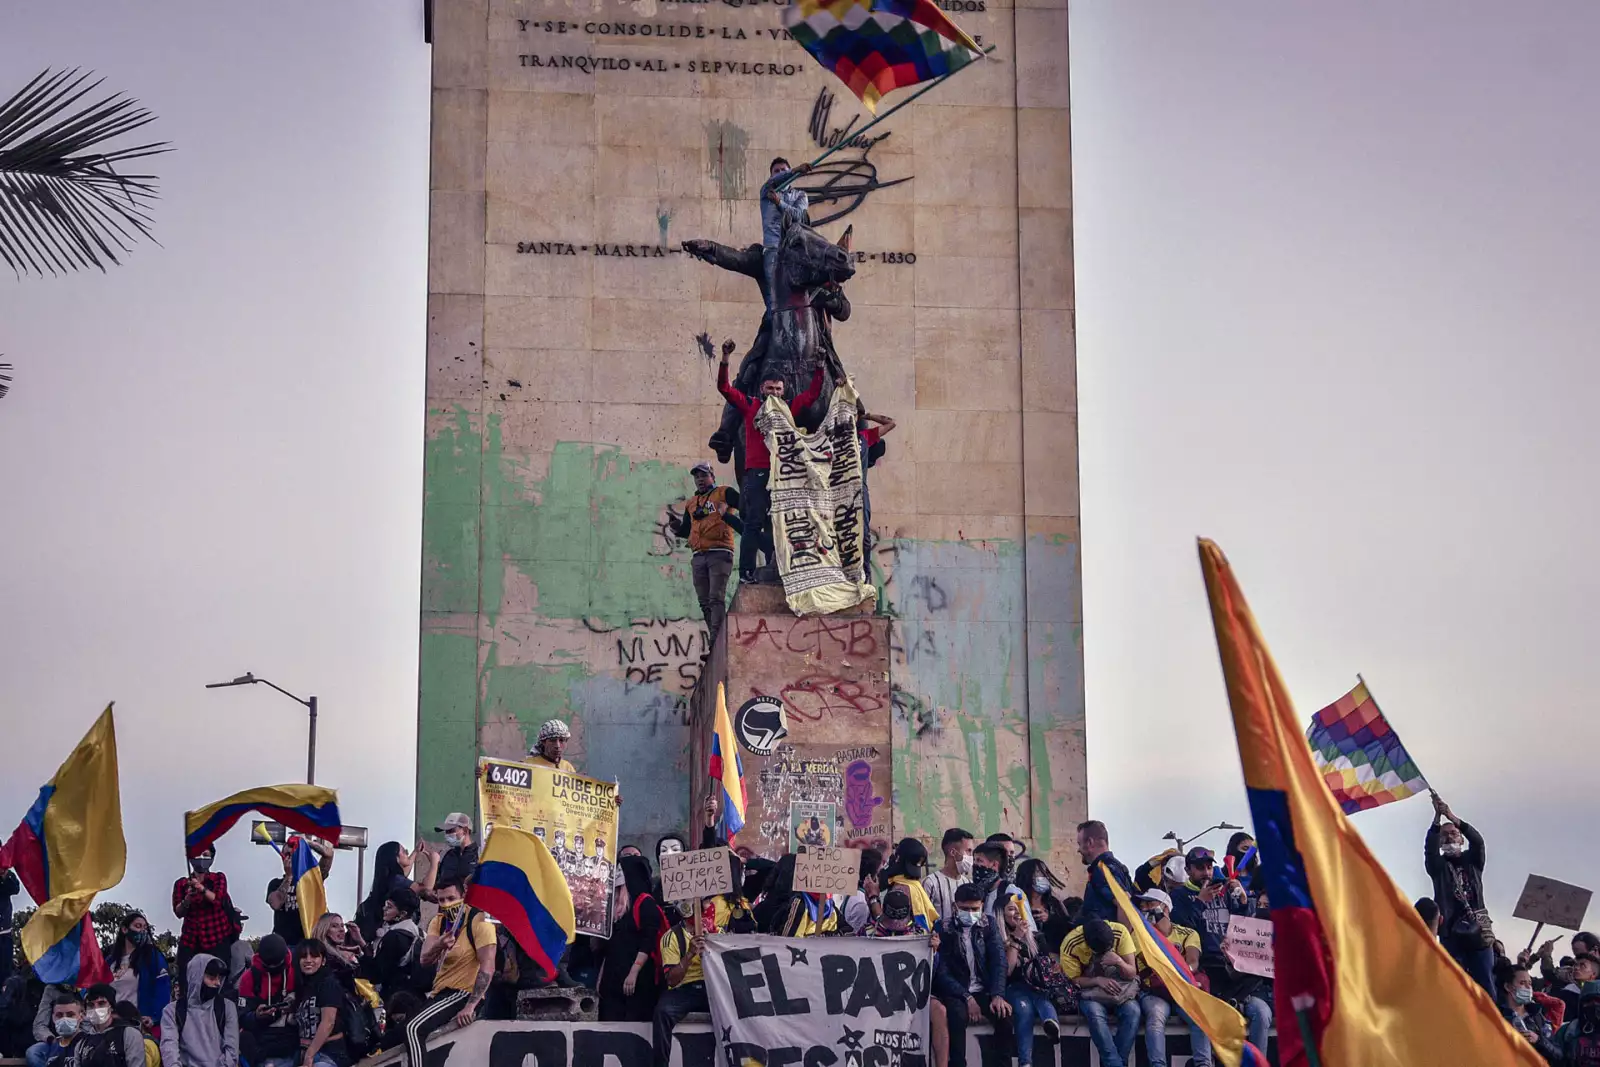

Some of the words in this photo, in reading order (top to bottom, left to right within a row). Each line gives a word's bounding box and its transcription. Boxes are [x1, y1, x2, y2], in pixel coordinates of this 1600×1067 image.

[545, 20, 567, 33] SE
[584, 22, 705, 38] CONSOLIDE
[722, 26, 747, 40] LA
[768, 28, 798, 41] VN
[519, 54, 630, 74] TRANQVILO
[642, 59, 667, 72] AL
[516, 241, 577, 256] SANTA
[593, 243, 665, 258] MARTA
[882, 251, 917, 265] 1830
[491, 765, 529, 787] 6.402
[552, 773, 593, 795] URIBE
[552, 786, 569, 800] LA
[571, 791, 616, 811] ORDEN
[661, 857, 674, 871] EL
[677, 850, 722, 866] PUEBLO
[808, 845, 842, 861] PERO
[664, 871, 684, 884] NO
[796, 862, 855, 875] TAMPOCO
[668, 875, 728, 898] ARMAS
[795, 875, 848, 890] MIEDO
[576, 919, 601, 931] erdad
[721, 947, 810, 1020] EL
[820, 950, 931, 1018] PARO
[875, 1032, 900, 1048] NOS
